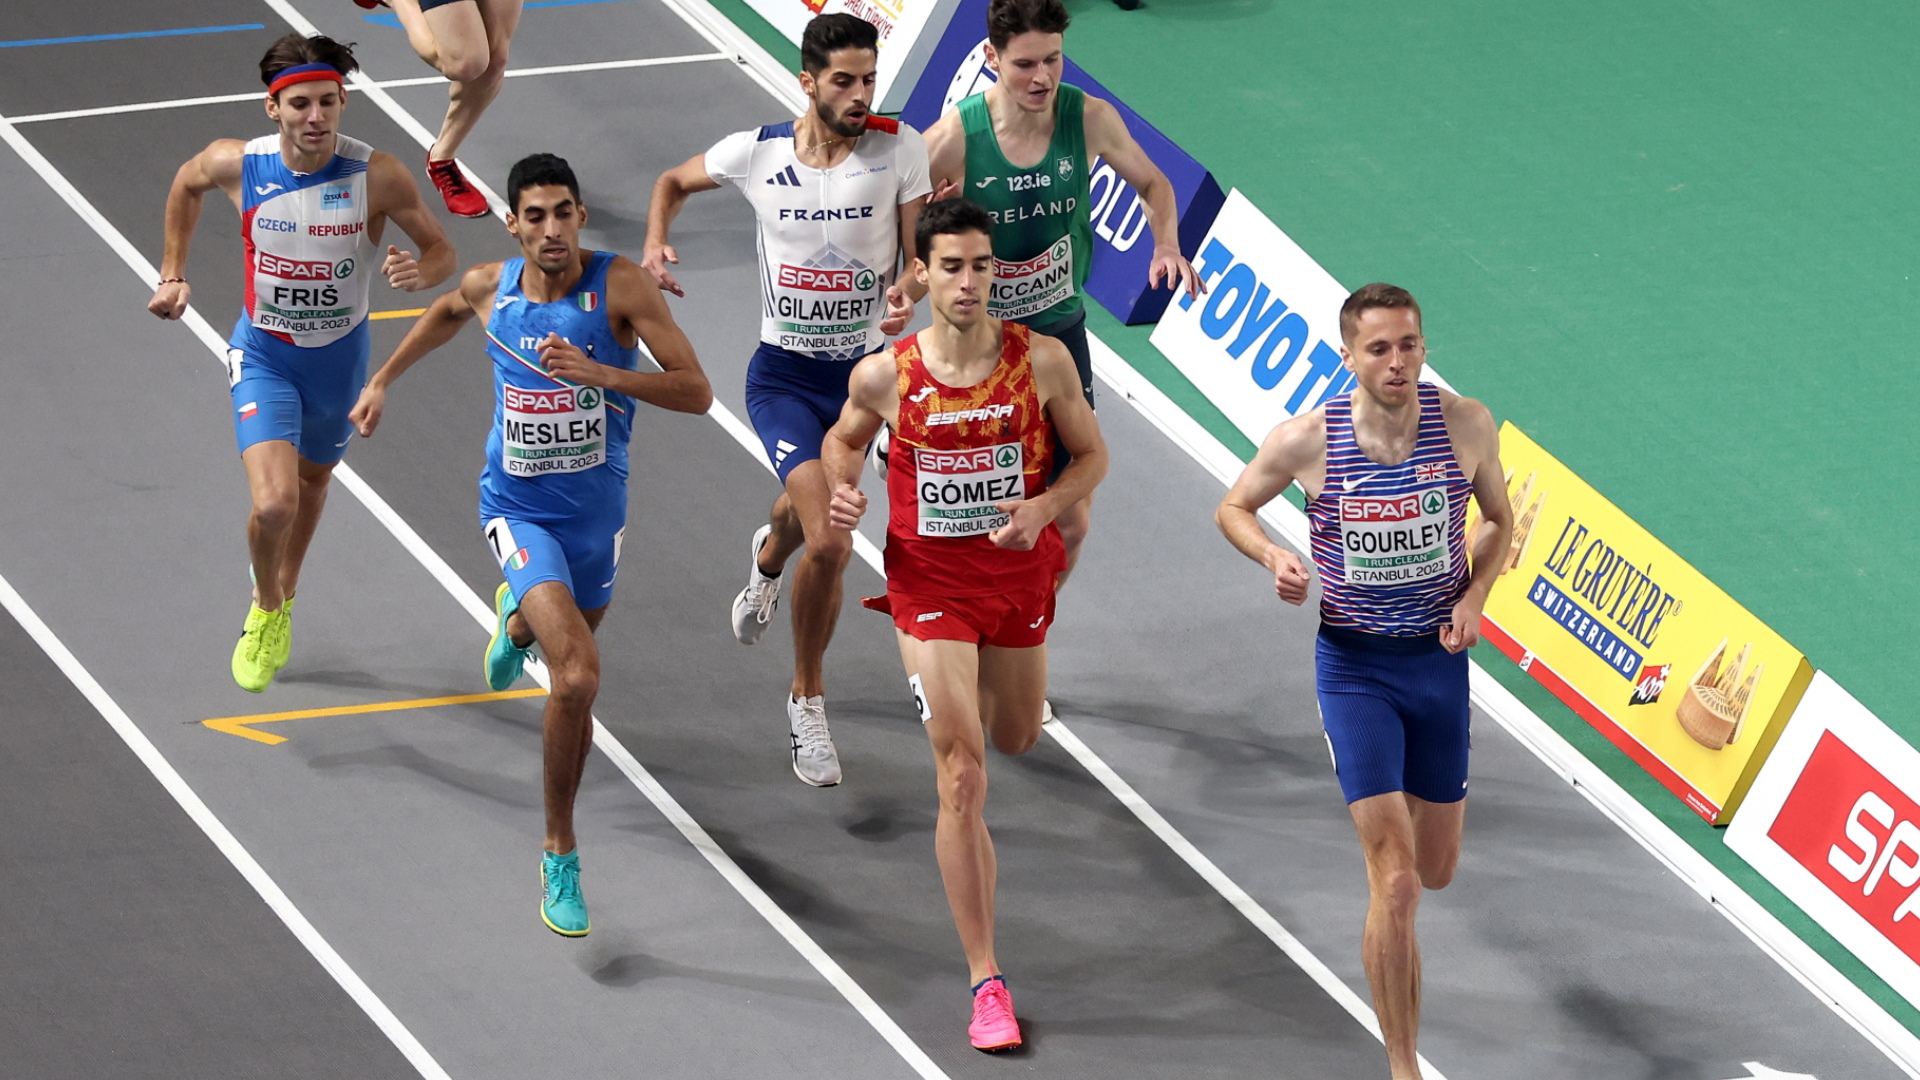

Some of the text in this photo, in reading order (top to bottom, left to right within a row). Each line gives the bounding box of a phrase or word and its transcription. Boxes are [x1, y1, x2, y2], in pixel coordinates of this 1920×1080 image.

[1007, 172, 1051, 192] 123.ie
[779, 205, 874, 221] FRANCE
[987, 197, 1077, 224] RELAND
[257, 217, 296, 232] CZECH
[260, 256, 331, 278] SPAR
[780, 268, 851, 289] SPAR
[274, 284, 339, 307] FRIŠ
[1003, 299, 1023, 309] RUN
[1043, 288, 1068, 307] 2023
[282, 309, 300, 318] RUN
[778, 296, 875, 321] GILAVERT
[260, 313, 351, 332] ISTANBUL 2023
[800, 326, 820, 334] RUN
[780, 331, 867, 348] ISTANBUL 2023
[506, 390, 573, 411] SPAR
[925, 404, 1015, 427] ESPAÑA
[506, 418, 602, 445] MESLEK
[509, 453, 599, 473] ISTANBUL 2023
[525, 449, 547, 458] RUN
[920, 452, 992, 471] SPAR
[921, 474, 1021, 505] GÓMEZ
[945, 509, 966, 518] RUN
[1343, 499, 1418, 519] SPAR
[925, 516, 1011, 533] ISTANBUL 202
[1346, 520, 1446, 554] GOURLEY
[1544, 516, 1589, 580] LE
[1352, 560, 1445, 582] ISTANBUL 2023
[1371, 558, 1393, 567] RUN
[916, 611, 943, 622] ESP
[1533, 582, 1636, 674] SWITZERLAND
